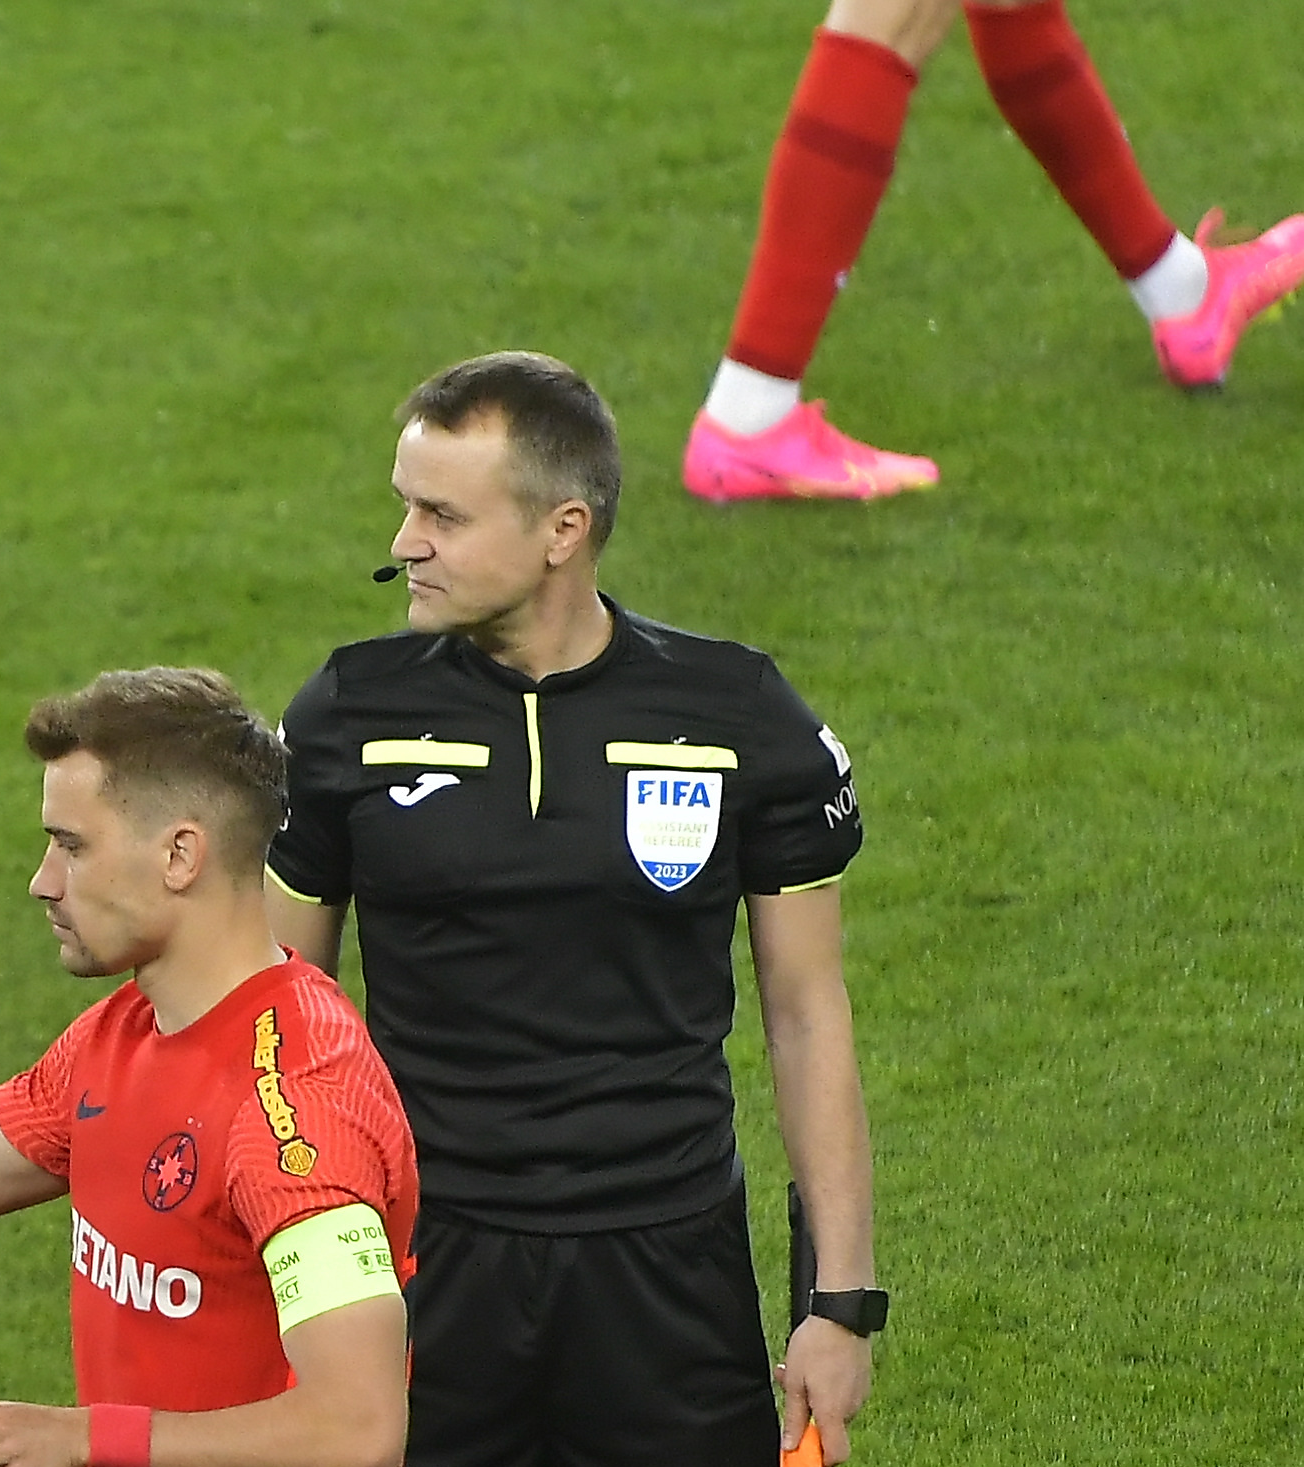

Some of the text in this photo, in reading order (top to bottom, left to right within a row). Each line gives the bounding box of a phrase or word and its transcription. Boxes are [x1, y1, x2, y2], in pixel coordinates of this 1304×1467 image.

[638, 780, 711, 808] FIFA
[654, 864, 687, 879] 2023
[337, 1230, 360, 1244] NO
